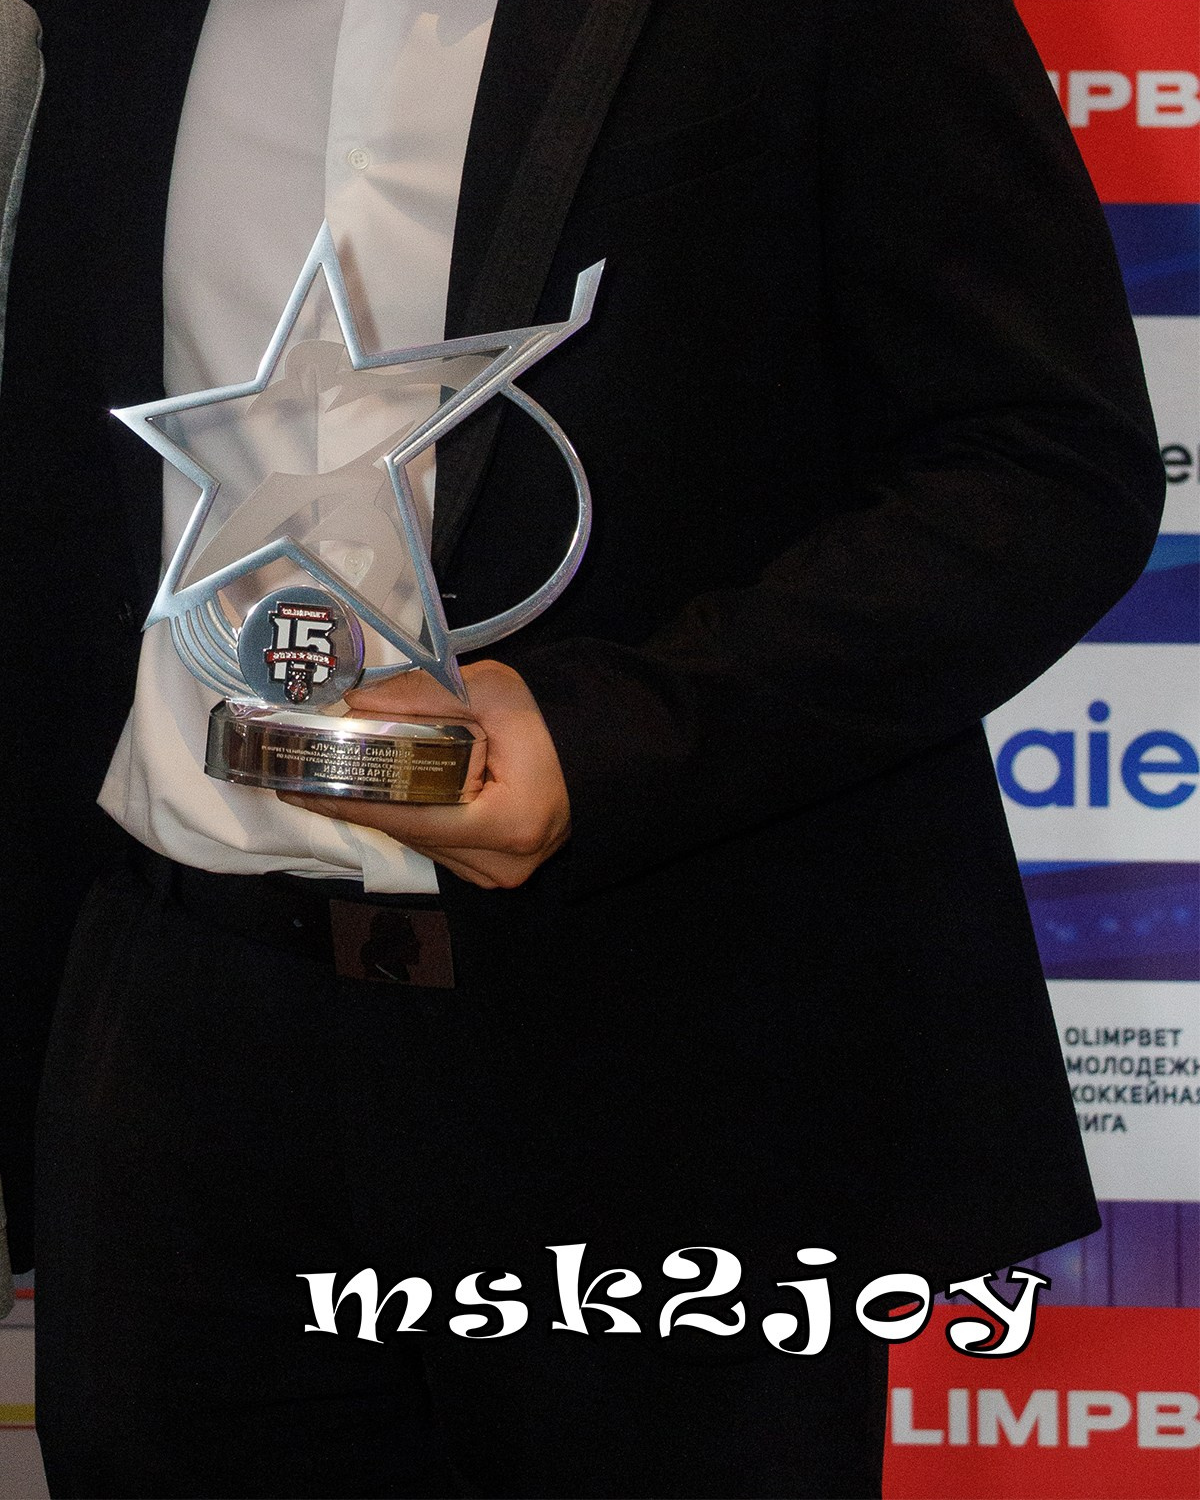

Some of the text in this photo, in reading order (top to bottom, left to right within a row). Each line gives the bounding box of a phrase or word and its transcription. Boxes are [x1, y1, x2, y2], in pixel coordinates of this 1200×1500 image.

[1046, 70, 1200, 128] PB
[274, 618, 333, 683] 15
[982, 699, 1200, 809] aie
[1064, 1027, 1182, 1047] OLIMPBET
[1077, 1113, 1128, 1133] ИГА
[891, 1387, 1200, 1449] LIMPB
